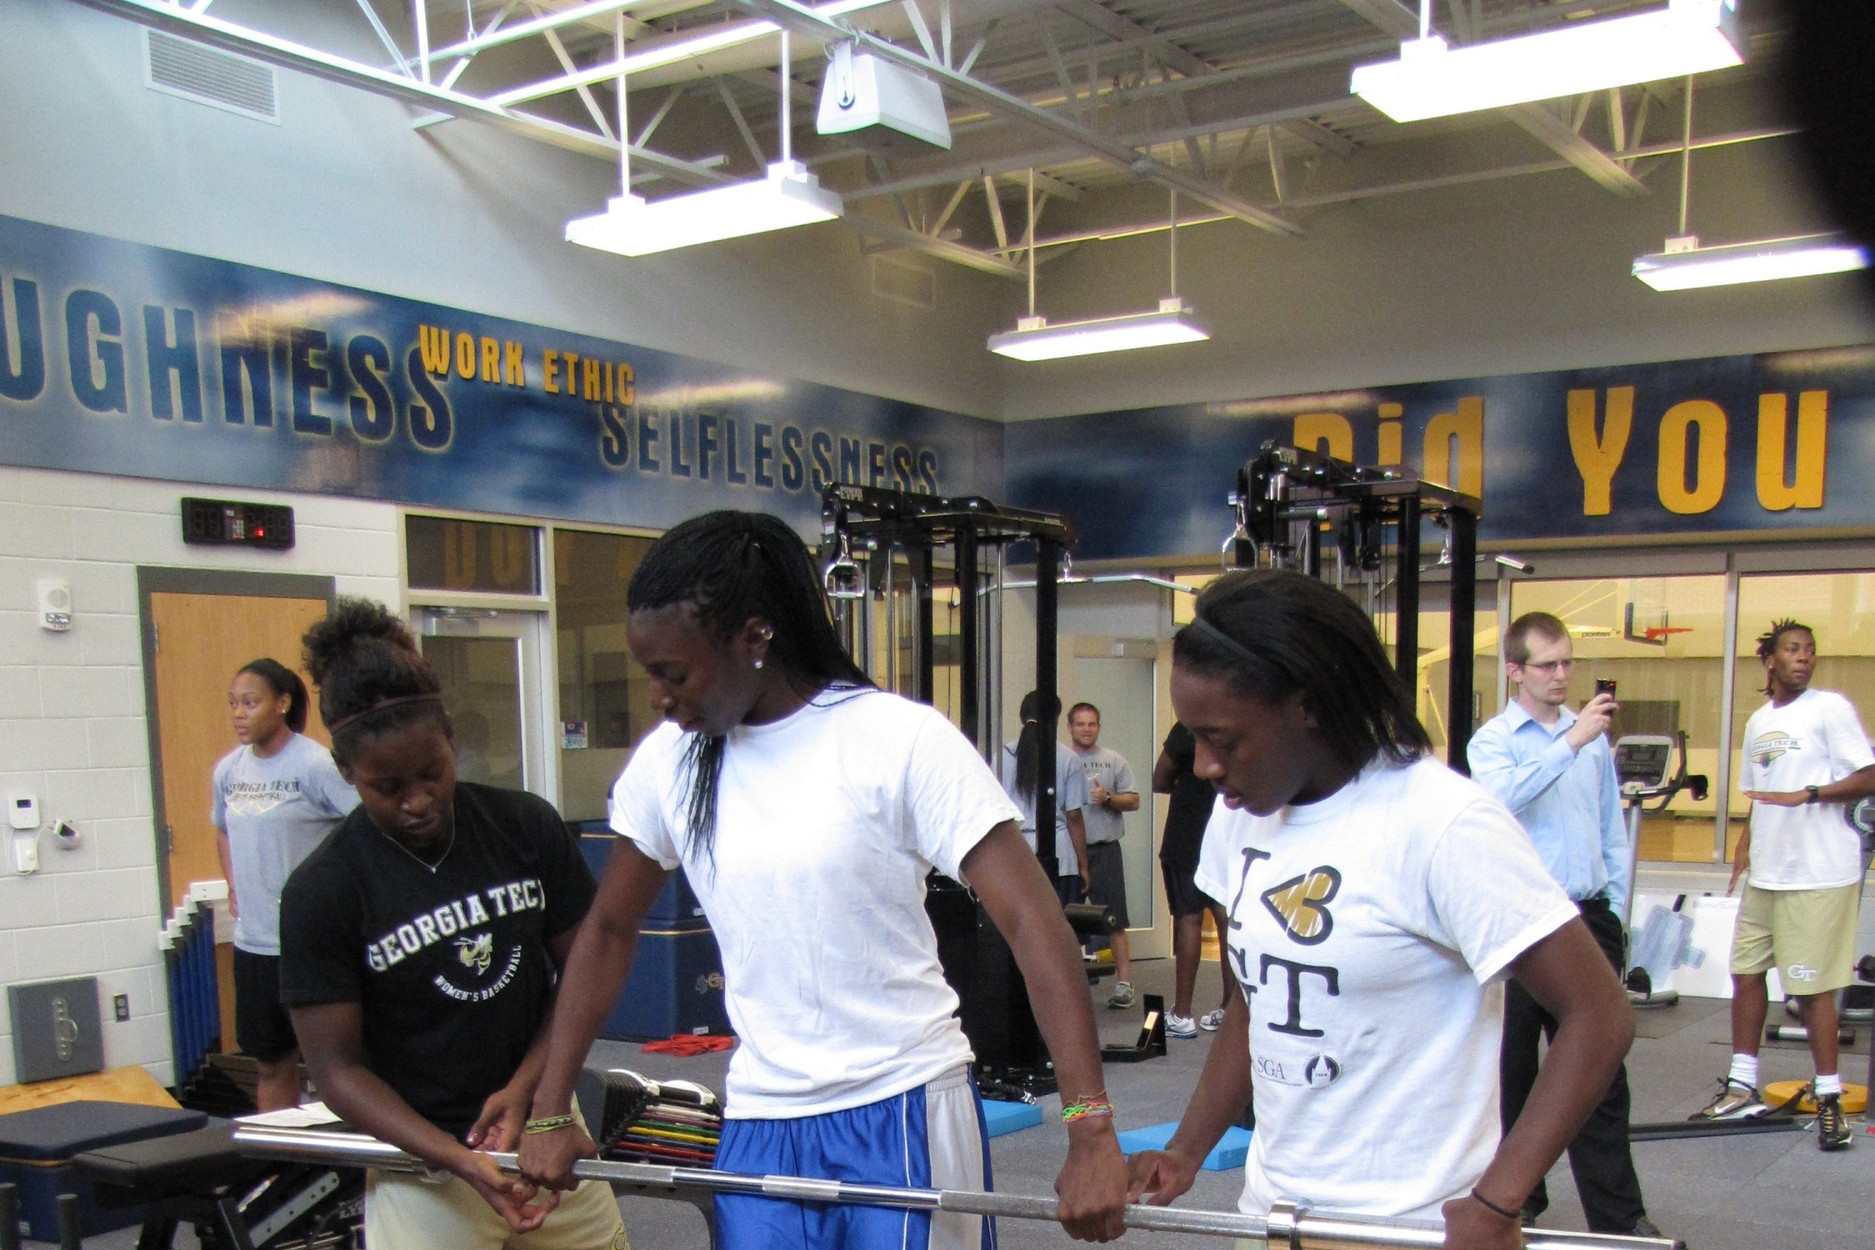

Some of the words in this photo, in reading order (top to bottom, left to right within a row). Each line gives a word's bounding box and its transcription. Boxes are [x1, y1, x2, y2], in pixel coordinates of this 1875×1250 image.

[419, 324, 525, 388] WORK
[543, 347, 635, 407] ETHIC
[601, 400, 937, 496] SELFLESSNESS
[1567, 385, 1828, 516] You
[367, 894, 490, 973] GEORGIA
[487, 878, 546, 917] TEC
[433, 974, 480, 1002] WOMEN'S
[482, 944, 522, 1000] BASKETBALL
[1257, 1056, 1286, 1080] SGA
